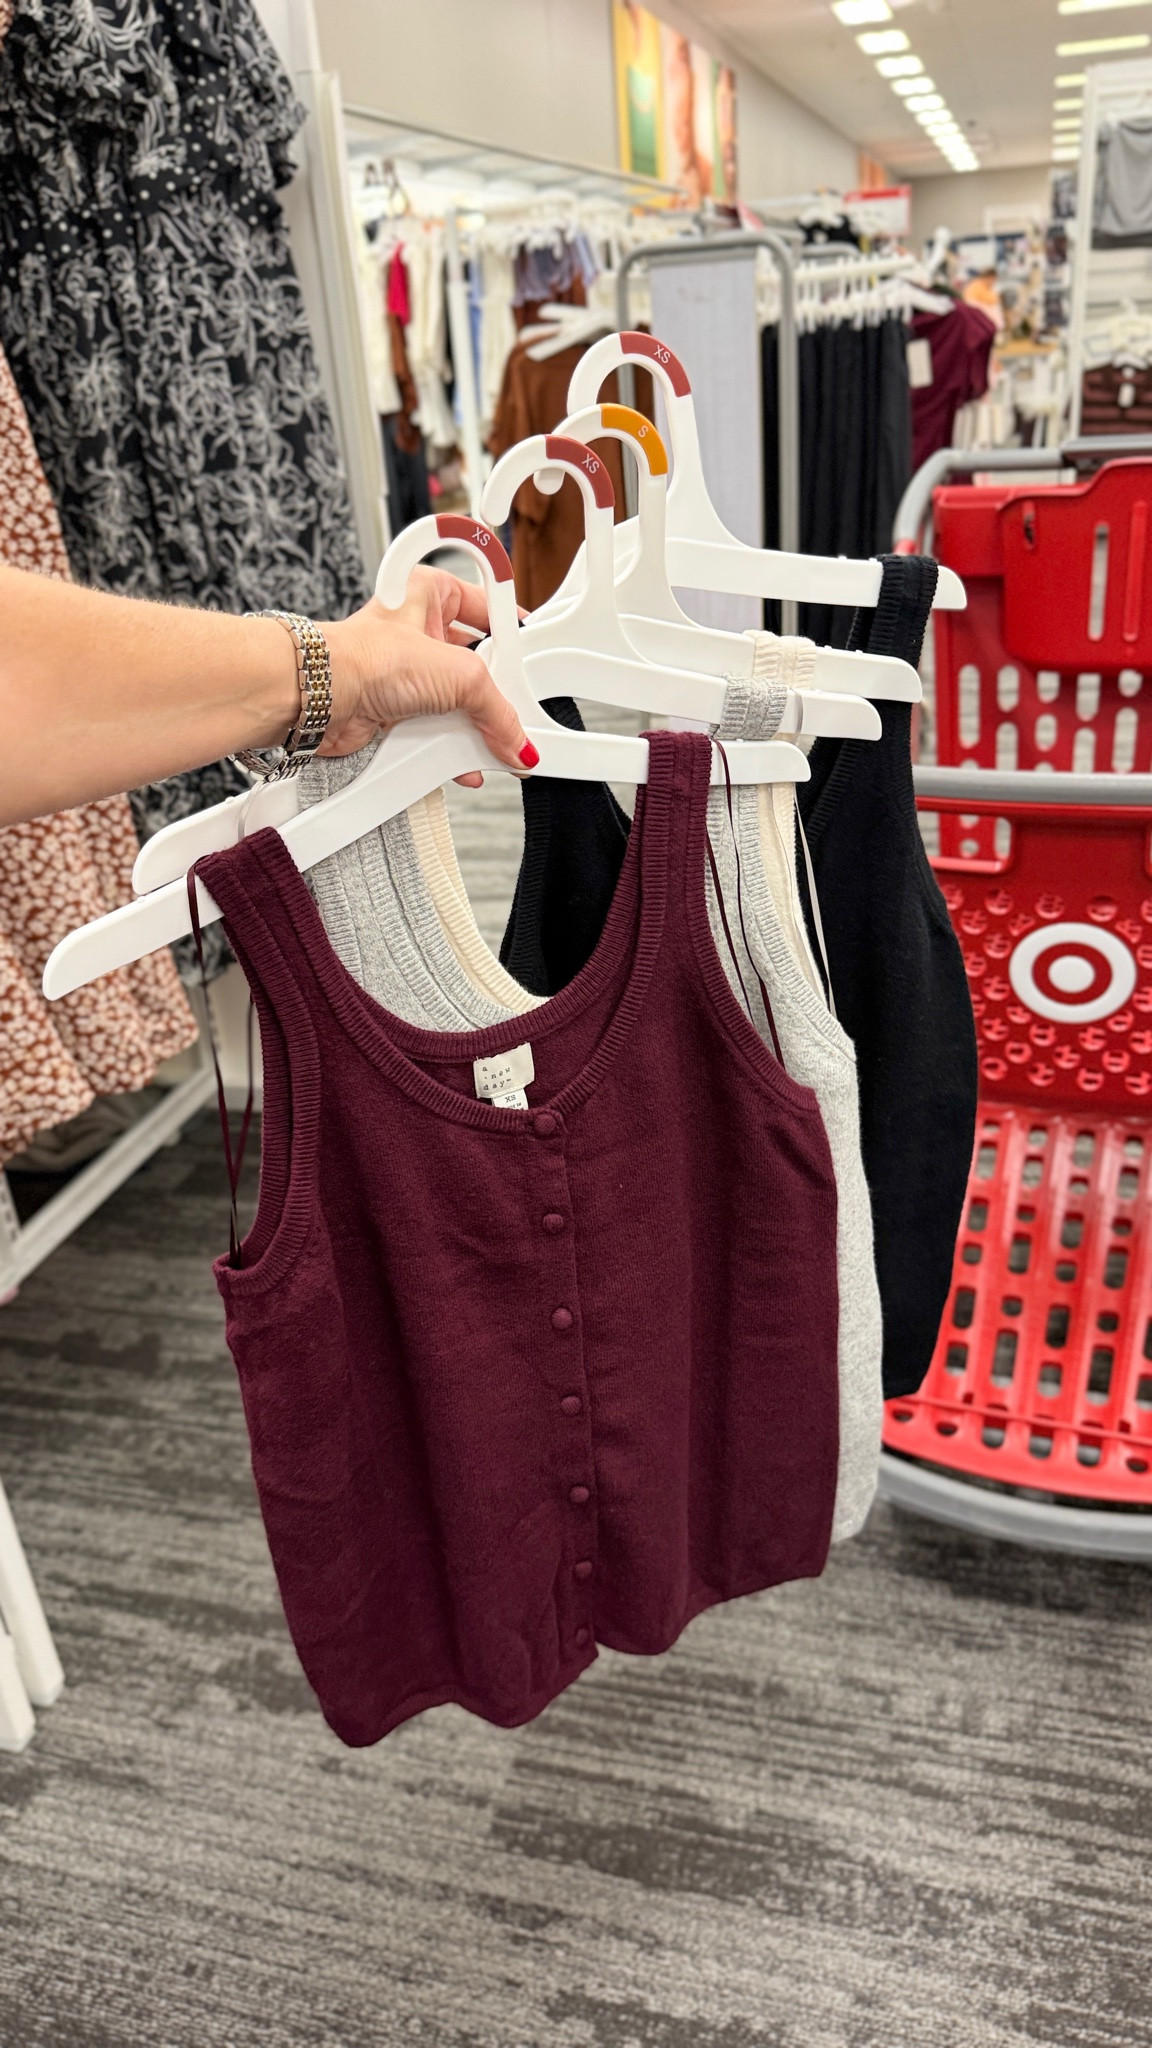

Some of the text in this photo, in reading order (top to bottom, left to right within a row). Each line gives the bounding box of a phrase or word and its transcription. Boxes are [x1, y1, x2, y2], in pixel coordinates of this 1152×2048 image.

[653, 344, 671, 364] XS
[637, 425, 649, 438] S
[581, 453, 600, 474] XS
[471, 526, 491, 547] XS
[504, 1094, 517, 1103] XS
